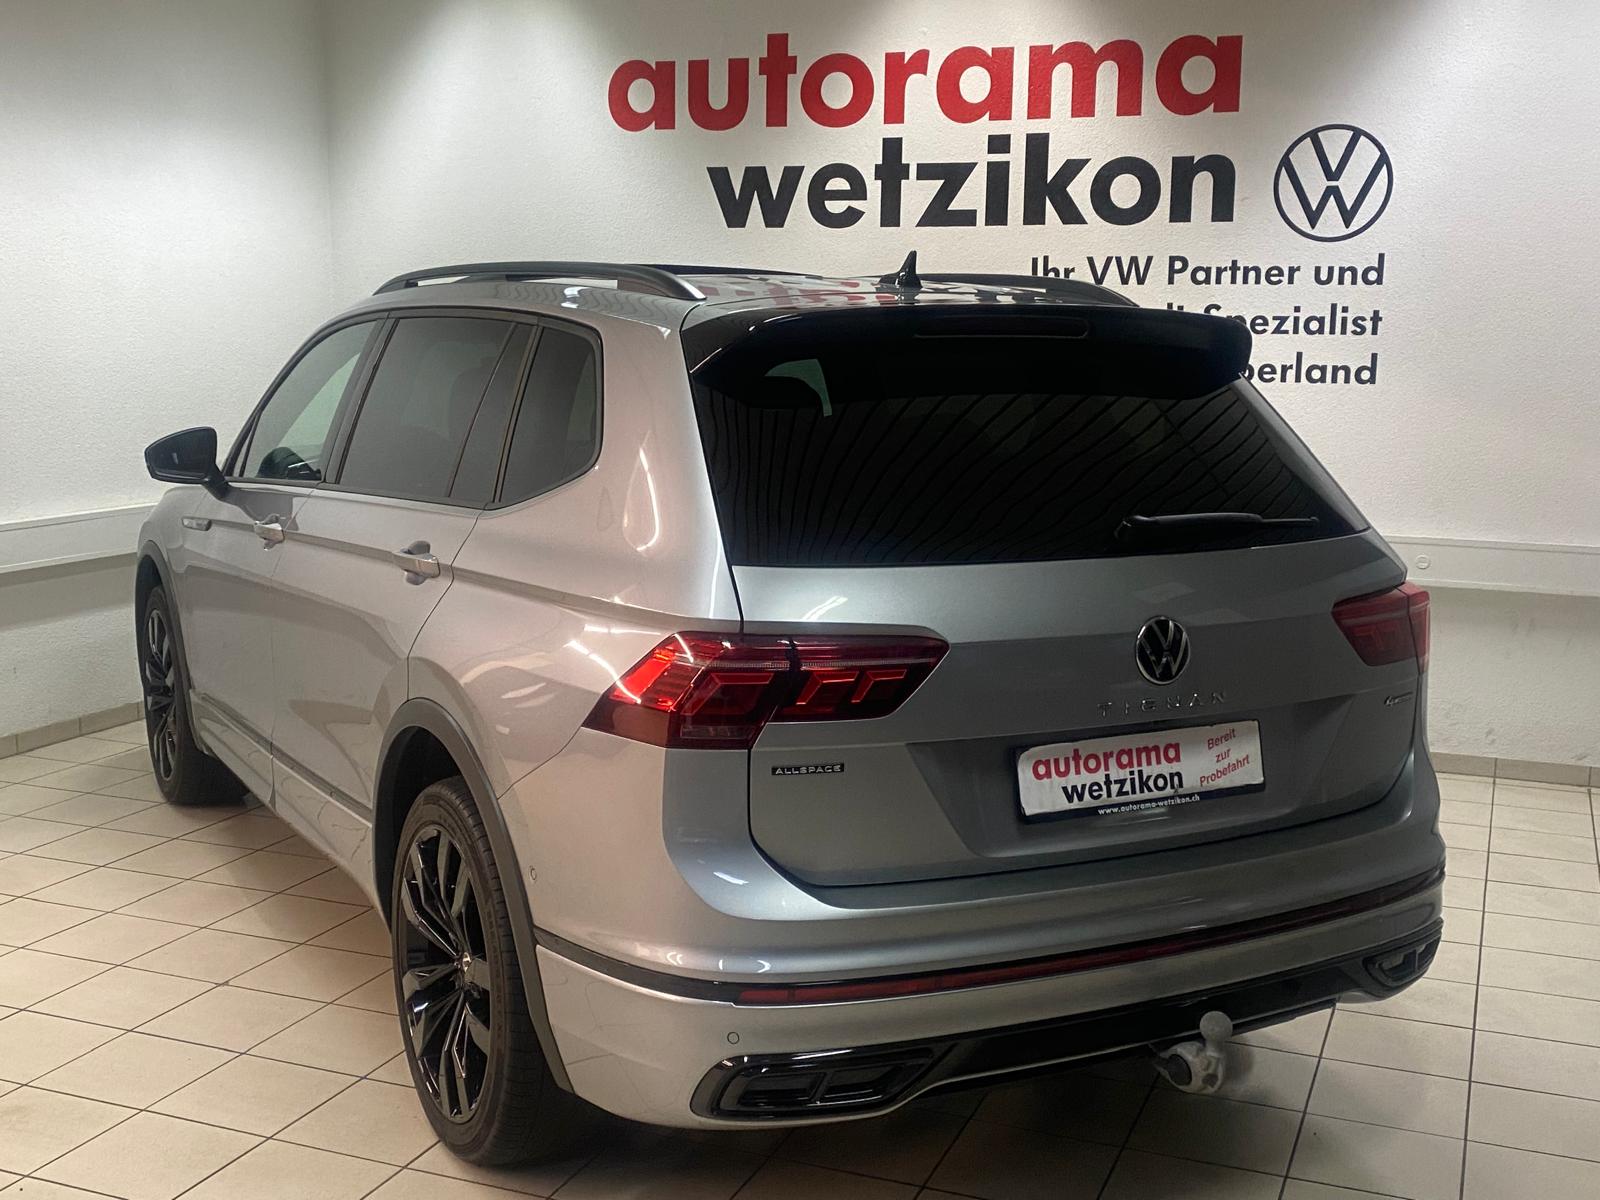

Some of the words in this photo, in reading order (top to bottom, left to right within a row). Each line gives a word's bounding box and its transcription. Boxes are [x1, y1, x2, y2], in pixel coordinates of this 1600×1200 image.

[608, 33, 1243, 132] autorama
[707, 133, 1235, 229] wetzikon
[1087, 256, 1153, 286] VW
[1168, 255, 1300, 286] Partner
[1314, 253, 1385, 286] und
[1204, 303, 1383, 336] ezialist
[1207, 728, 1236, 750] Bereit
[1215, 748, 1231, 763] zur
[775, 765, 841, 775] ALLSPACE
[1032, 742, 1181, 780] autorama
[1200, 754, 1251, 787] Probefahrt
[1061, 770, 1184, 804] wetzikon
[1097, 794, 1200, 816] www.autorama-wetzikon.ch
